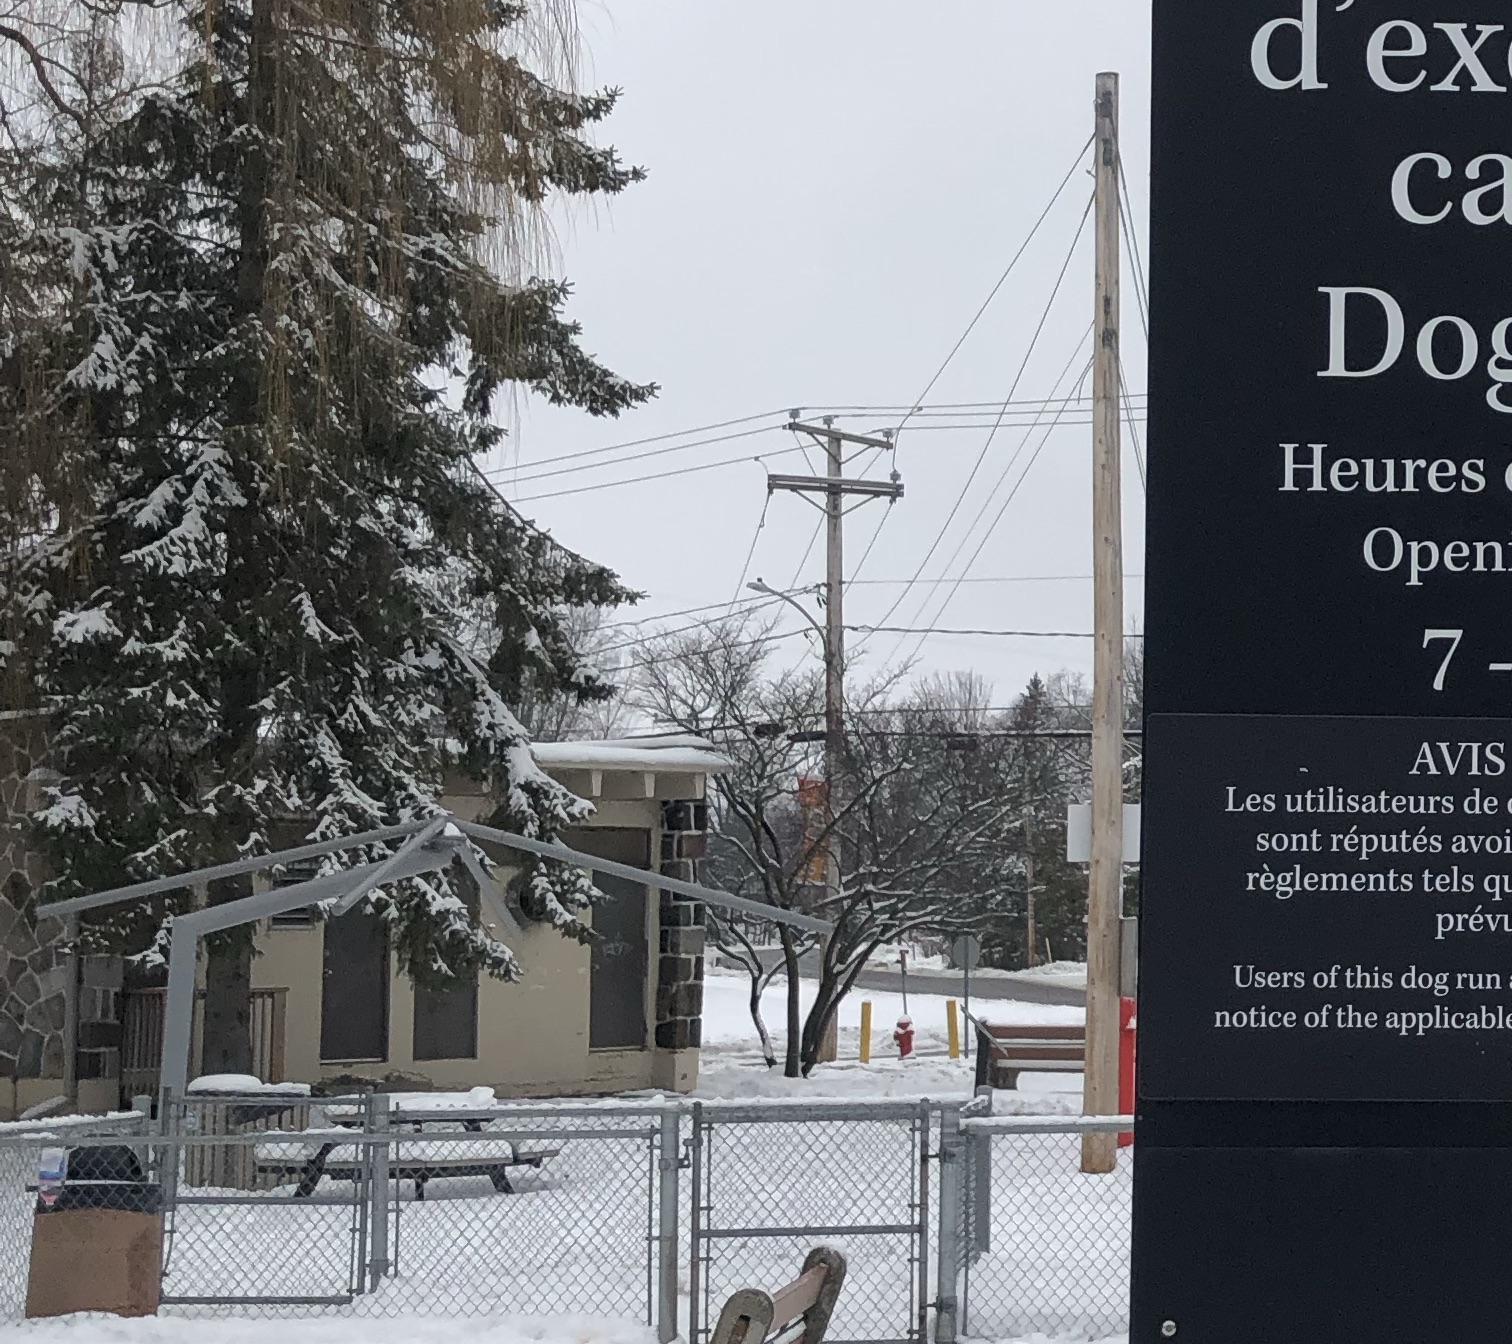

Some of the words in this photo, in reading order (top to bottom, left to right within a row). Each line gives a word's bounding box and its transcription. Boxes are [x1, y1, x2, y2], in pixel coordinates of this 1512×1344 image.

[1277, 443, 1486, 493] Heures
[1422, 628, 1464, 691] 7
[1408, 741, 1506, 776] AVIS
[1224, 786, 1276, 813] Les
[1284, 785, 1455, 814] utilisateurs
[1463, 787, 1499, 815] de
[1256, 828, 1323, 852] sont
[1329, 824, 1443, 861] réputés
[1245, 862, 1414, 900] règlements
[1421, 865, 1475, 893] tels
[1232, 964, 1306, 989] Users
[1312, 964, 1342, 989] of
[1344, 964, 1394, 989] this
[1400, 964, 1450, 997] dog
[1455, 972, 1503, 990] run
[1213, 1004, 1297, 1028] notice
[1303, 1003, 1333, 1028] of
[1335, 1004, 1378, 1029] the
